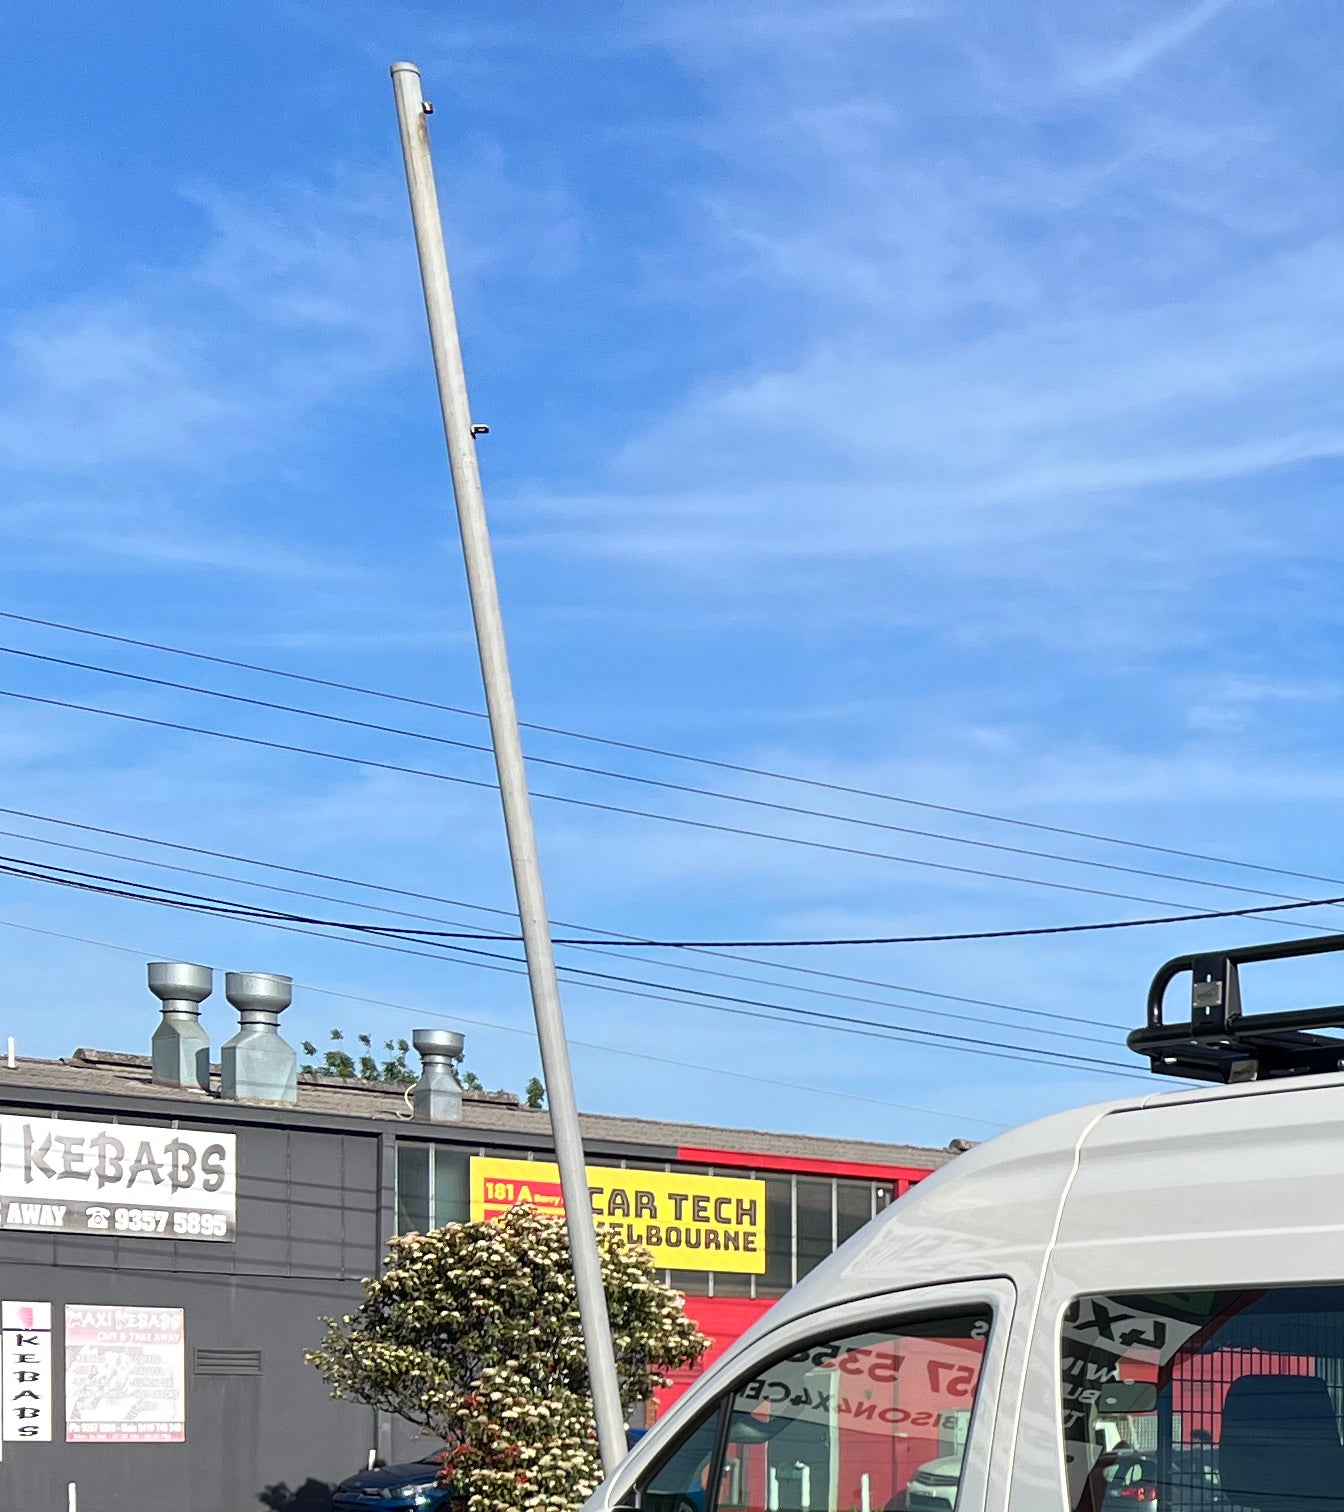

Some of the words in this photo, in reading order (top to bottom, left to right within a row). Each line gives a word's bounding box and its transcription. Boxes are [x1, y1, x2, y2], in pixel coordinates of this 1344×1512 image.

[22, 1123, 227, 1195] KEBABS
[485, 1181, 515, 1201] 181
[517, 1185, 533, 1203] A
[588, 1186, 658, 1220] CAR
[668, 1192, 758, 1227] TECH
[6, 1202, 67, 1227] AWAY
[114, 1208, 170, 1233] 9357
[173, 1211, 228, 1237] 5895
[596, 1221, 759, 1253] ELBOURNE
[67, 1309, 112, 1329] MAXI
[12, 1333, 41, 1437] KEBABS
